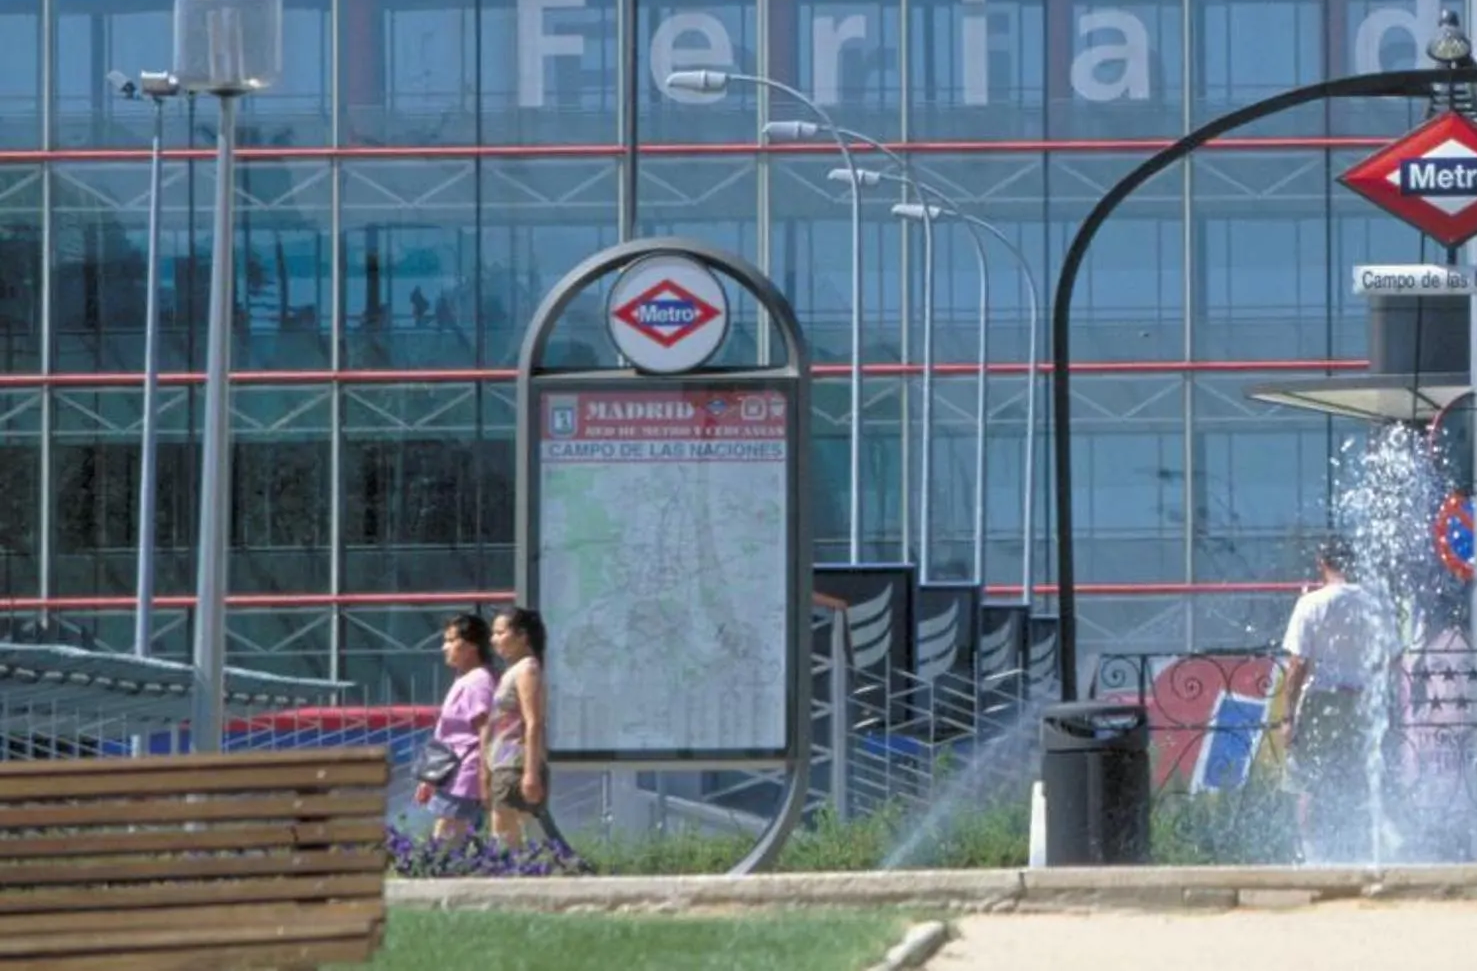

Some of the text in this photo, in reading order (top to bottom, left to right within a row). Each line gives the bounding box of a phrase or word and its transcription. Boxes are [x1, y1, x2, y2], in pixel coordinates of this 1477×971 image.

[1362, 270, 1415, 290] Campo
[1421, 270, 1441, 289] de
[1446, 270, 1468, 289] las
[640, 304, 694, 323] Metro
[585, 401, 695, 420] MADRID
[549, 442, 783, 458] CAMPO DE LAS NACIONES
